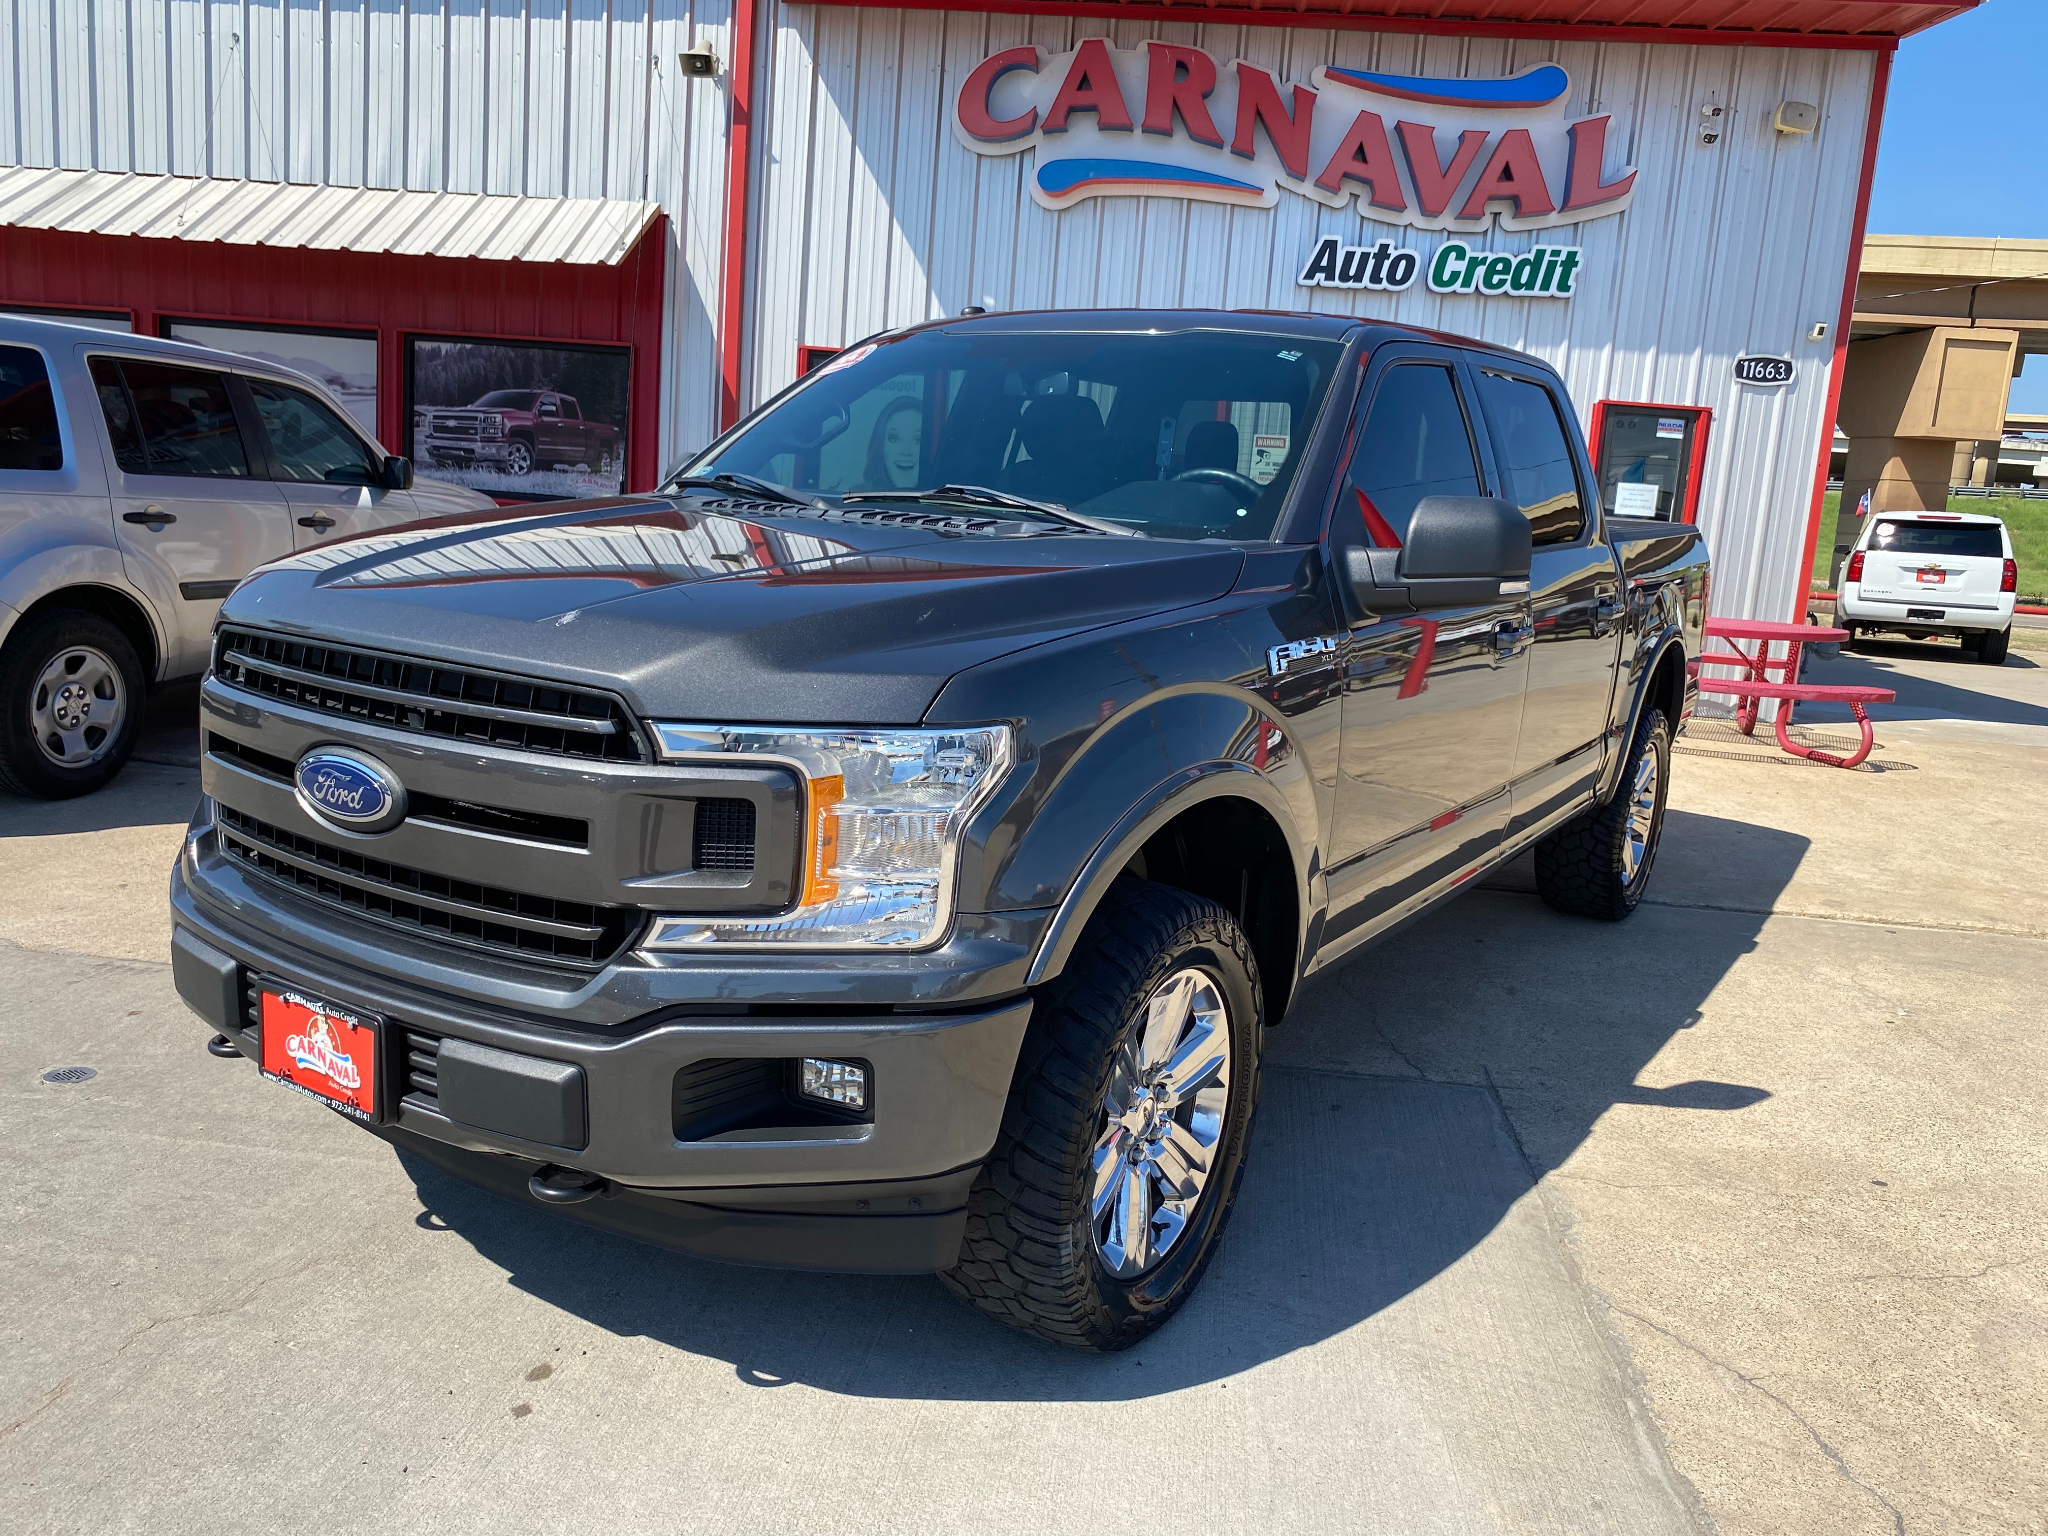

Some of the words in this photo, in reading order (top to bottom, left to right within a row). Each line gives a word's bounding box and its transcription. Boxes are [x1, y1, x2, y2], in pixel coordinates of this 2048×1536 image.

[957, 39, 1638, 220] CARNAVAL
[1301, 238, 1418, 286] Auto
[1432, 244, 1579, 293] Credit
[1742, 361, 1785, 379] 11663
[1257, 438, 1284, 447] WARNING
[575, 477, 618, 490] CARNAVAL
[1321, 653, 1334, 662] XLT
[313, 768, 371, 810] Ford
[286, 992, 326, 1014] CARNAVAL
[325, 1007, 340, 1019] Auto
[340, 1012, 358, 1025] Credit
[286, 1034, 360, 1086] CARNAVAL
[263, 1071, 327, 1104] www.CarnavalAutos.com
[331, 1099, 370, 1121] 972-241-8141
[328, 1080, 340, 1089] Auto
[340, 1084, 353, 1096] Credit
[1229, 1021, 1252, 1156] YOKOHAMA
